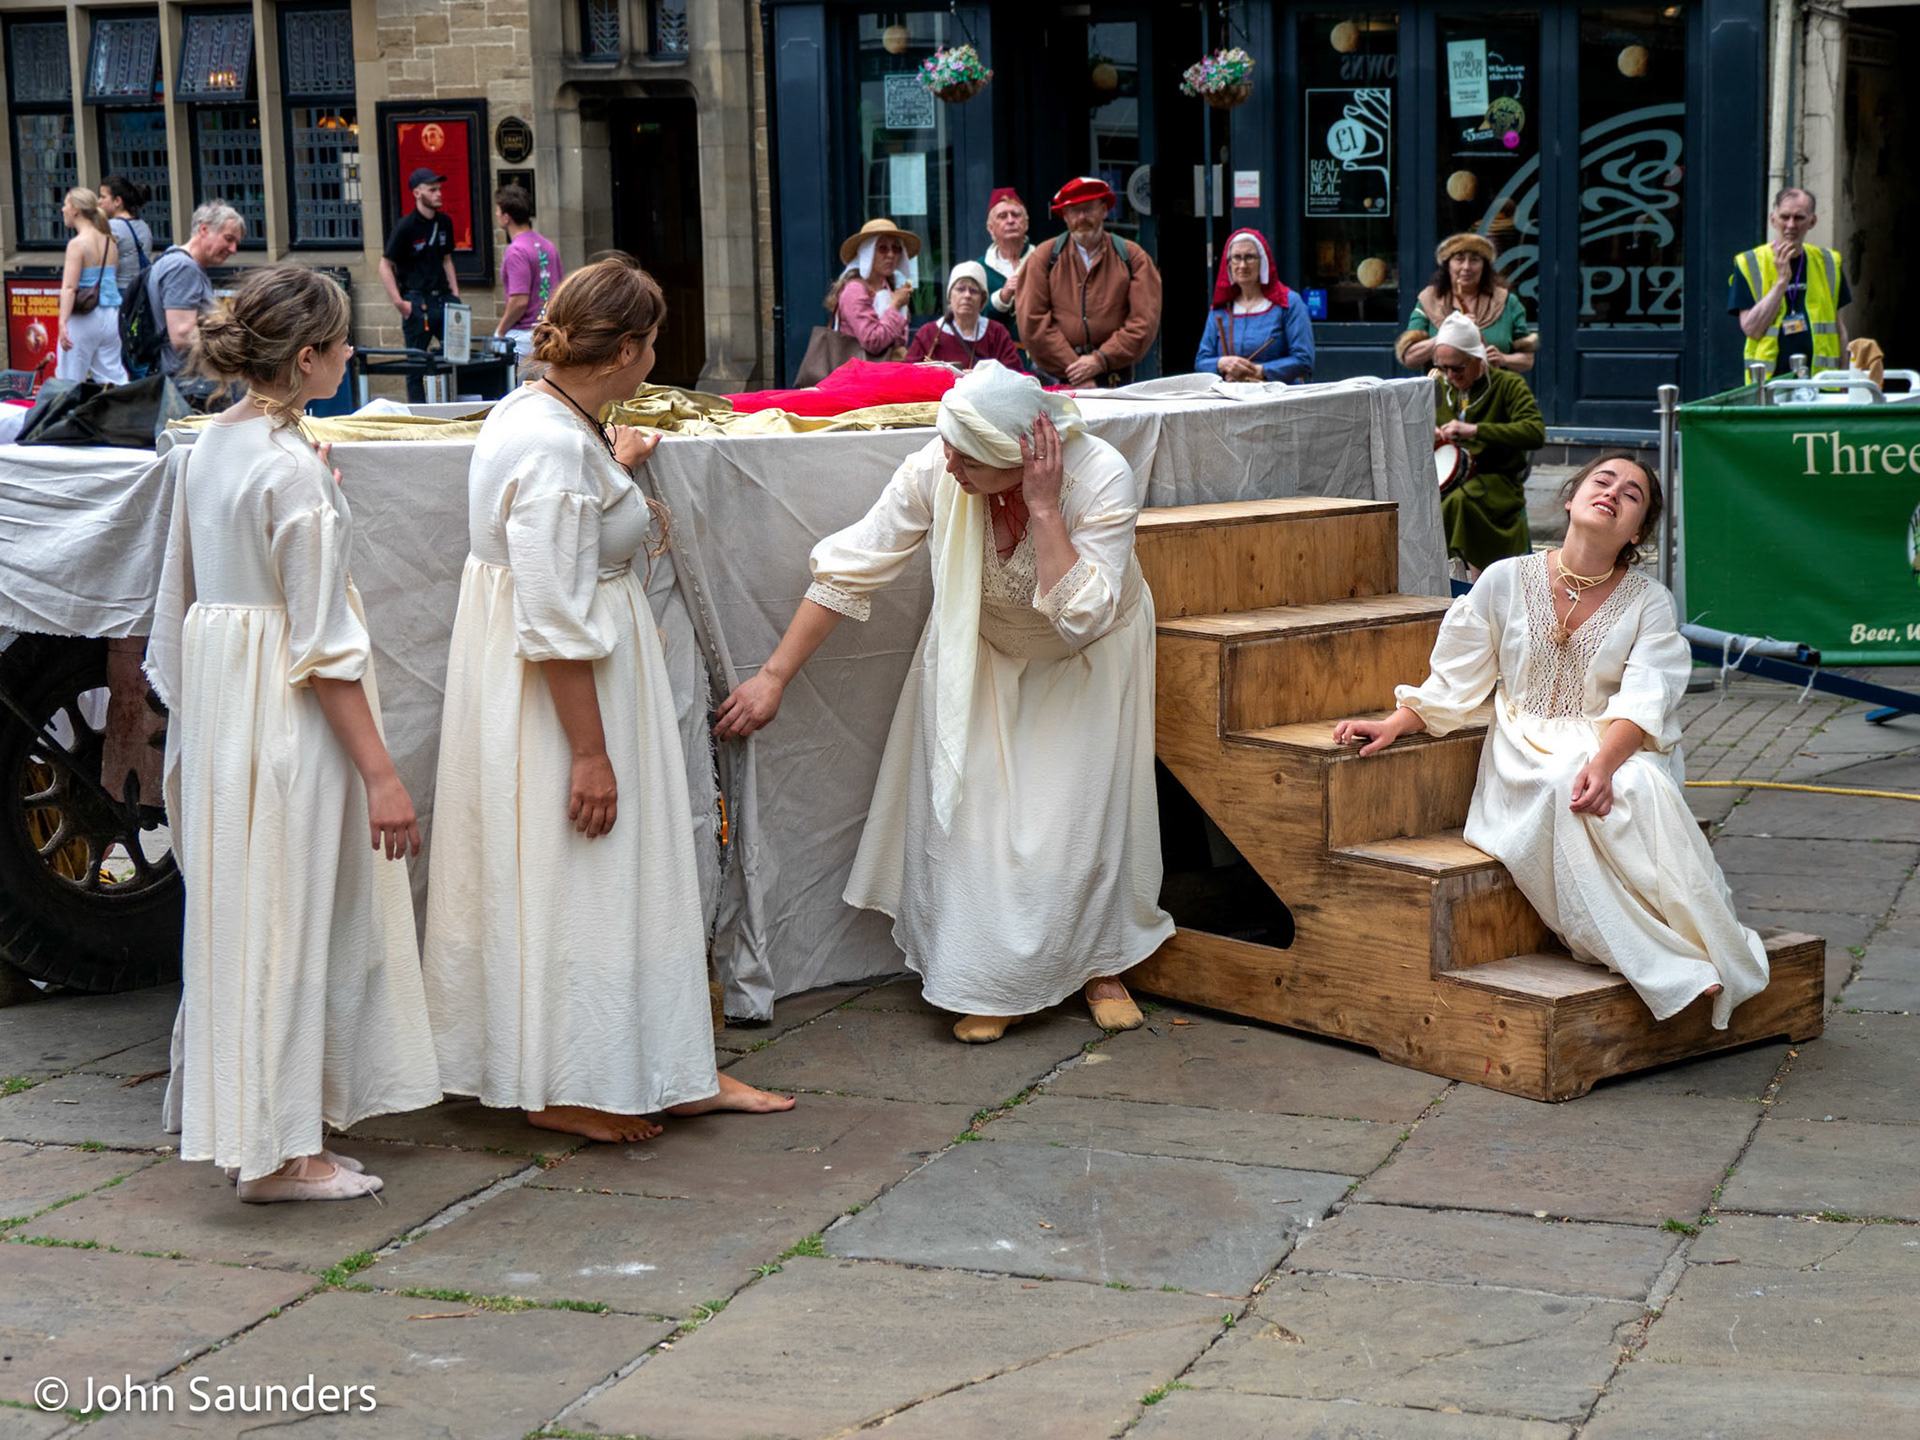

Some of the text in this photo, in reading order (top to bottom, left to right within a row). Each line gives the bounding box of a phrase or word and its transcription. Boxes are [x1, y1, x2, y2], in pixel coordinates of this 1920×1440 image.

[1488, 65, 1514, 73] What's
[1454, 69, 1483, 80] LUNCH
[1489, 73, 1524, 81] this week
[1335, 125, 1359, 155] £1
[12, 296, 26, 306] ALL
[12, 306, 26, 316] ALL
[1850, 623, 1901, 645] Beer,
